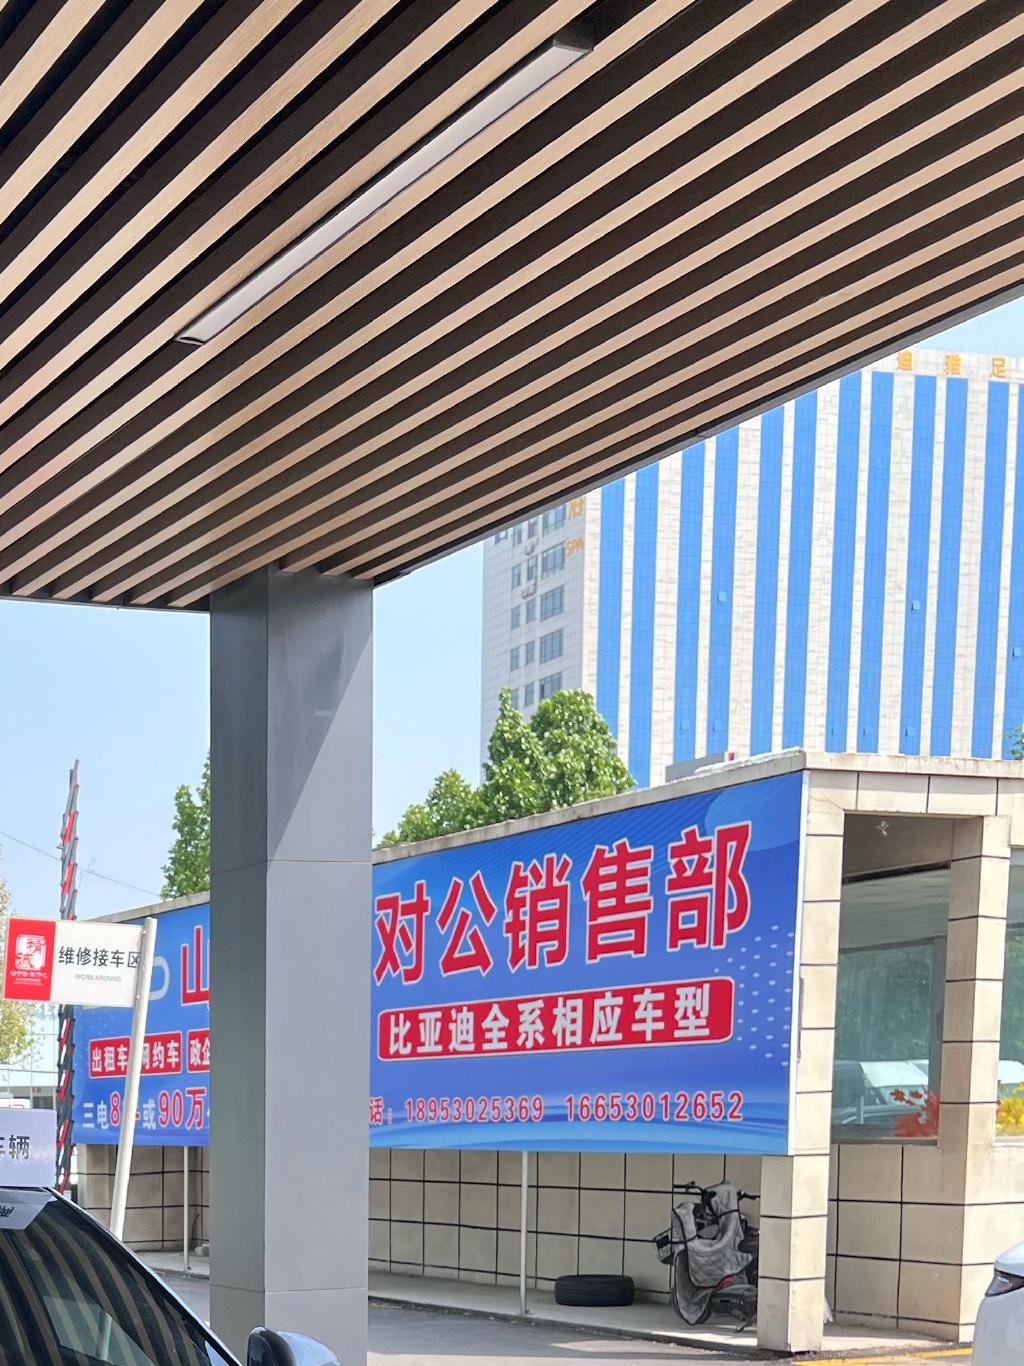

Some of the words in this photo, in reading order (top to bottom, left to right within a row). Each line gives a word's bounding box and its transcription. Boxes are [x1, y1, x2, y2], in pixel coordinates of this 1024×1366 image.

[374, 820, 752, 985] 对公销售部
[58, 946, 141, 968] 维修接车区
[91, 1045, 128, 1073] 出租车
[388, 982, 711, 1057] 比亚迪全系相应车型
[405, 1095, 544, 1123] 18953025369
[565, 1090, 744, 1122] 16653012652
